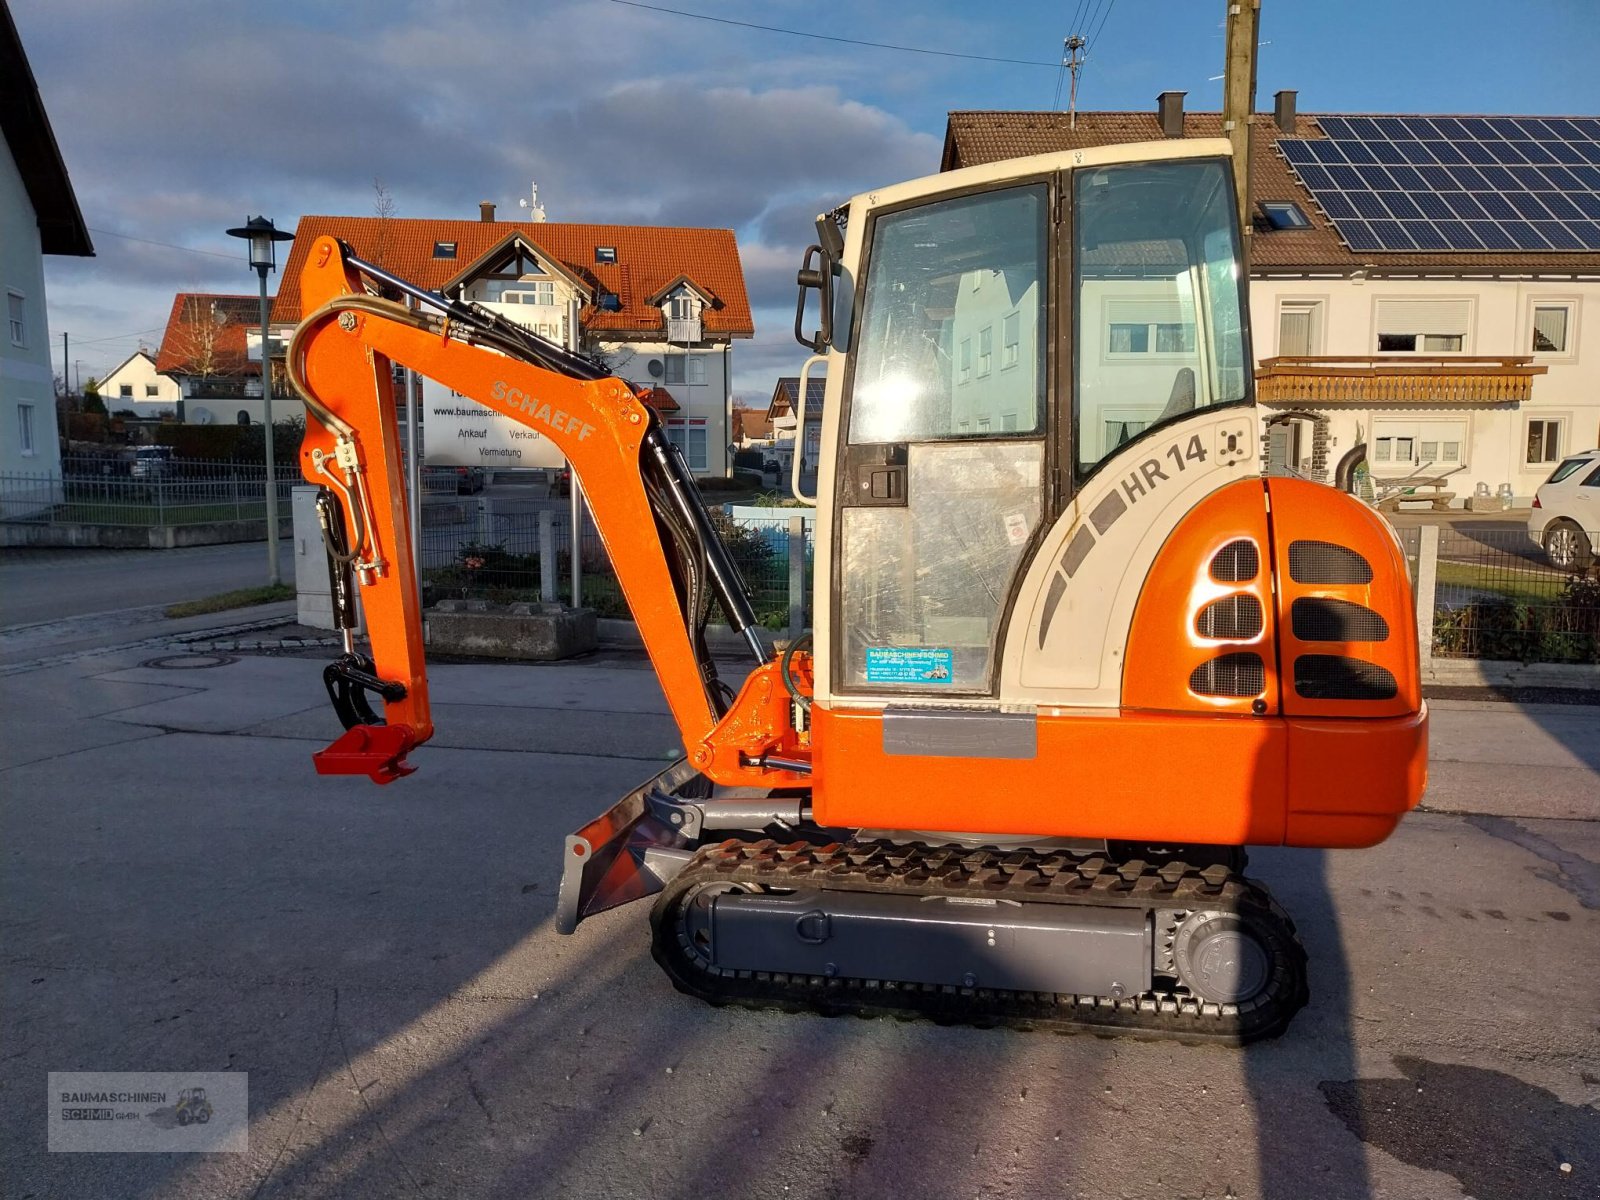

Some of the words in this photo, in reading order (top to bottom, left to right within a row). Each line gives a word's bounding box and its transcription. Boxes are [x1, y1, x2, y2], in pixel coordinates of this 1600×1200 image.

[491, 380, 596, 441] SCHAEFF
[458, 428, 487, 439] Ankauf
[479, 447, 522, 459] Vermietung
[1121, 458, 1170, 504] HR
[1167, 434, 1207, 472] 14
